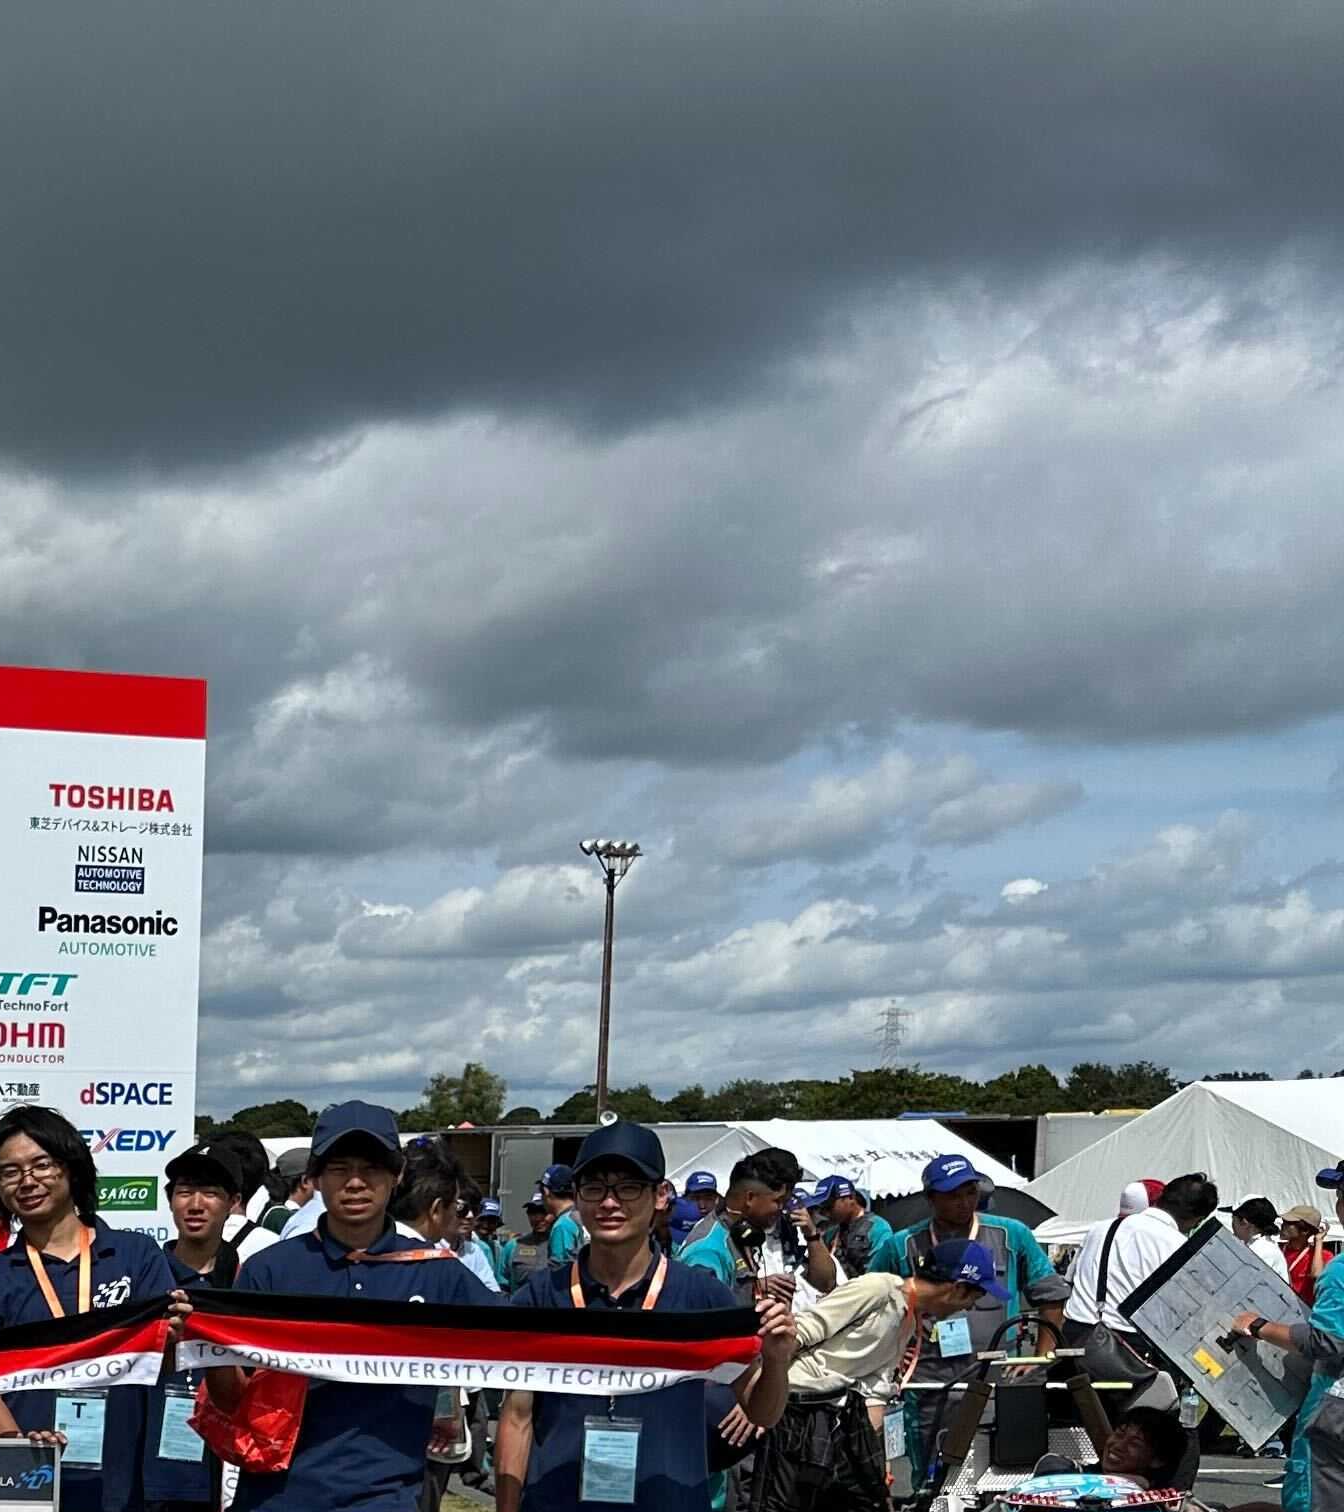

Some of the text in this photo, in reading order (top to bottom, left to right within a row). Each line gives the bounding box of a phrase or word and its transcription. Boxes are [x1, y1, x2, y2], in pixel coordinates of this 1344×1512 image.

[49, 783, 175, 812] TOSHIBA
[77, 845, 143, 864] NISSAN
[77, 867, 143, 881] AUTOMOTIVE
[77, 879, 143, 892] TECHNOLOGY
[38, 906, 178, 937] Panasonic
[59, 941, 157, 957] AUTOMOTIVE
[43, 1001, 69, 1012] Fort
[80, 1082, 173, 1106] dSPACE
[98, 1187, 148, 1200] SANGO
[345, 1358, 536, 1383] UNIVERSITY OF
[72, 1402, 87, 1418] T
